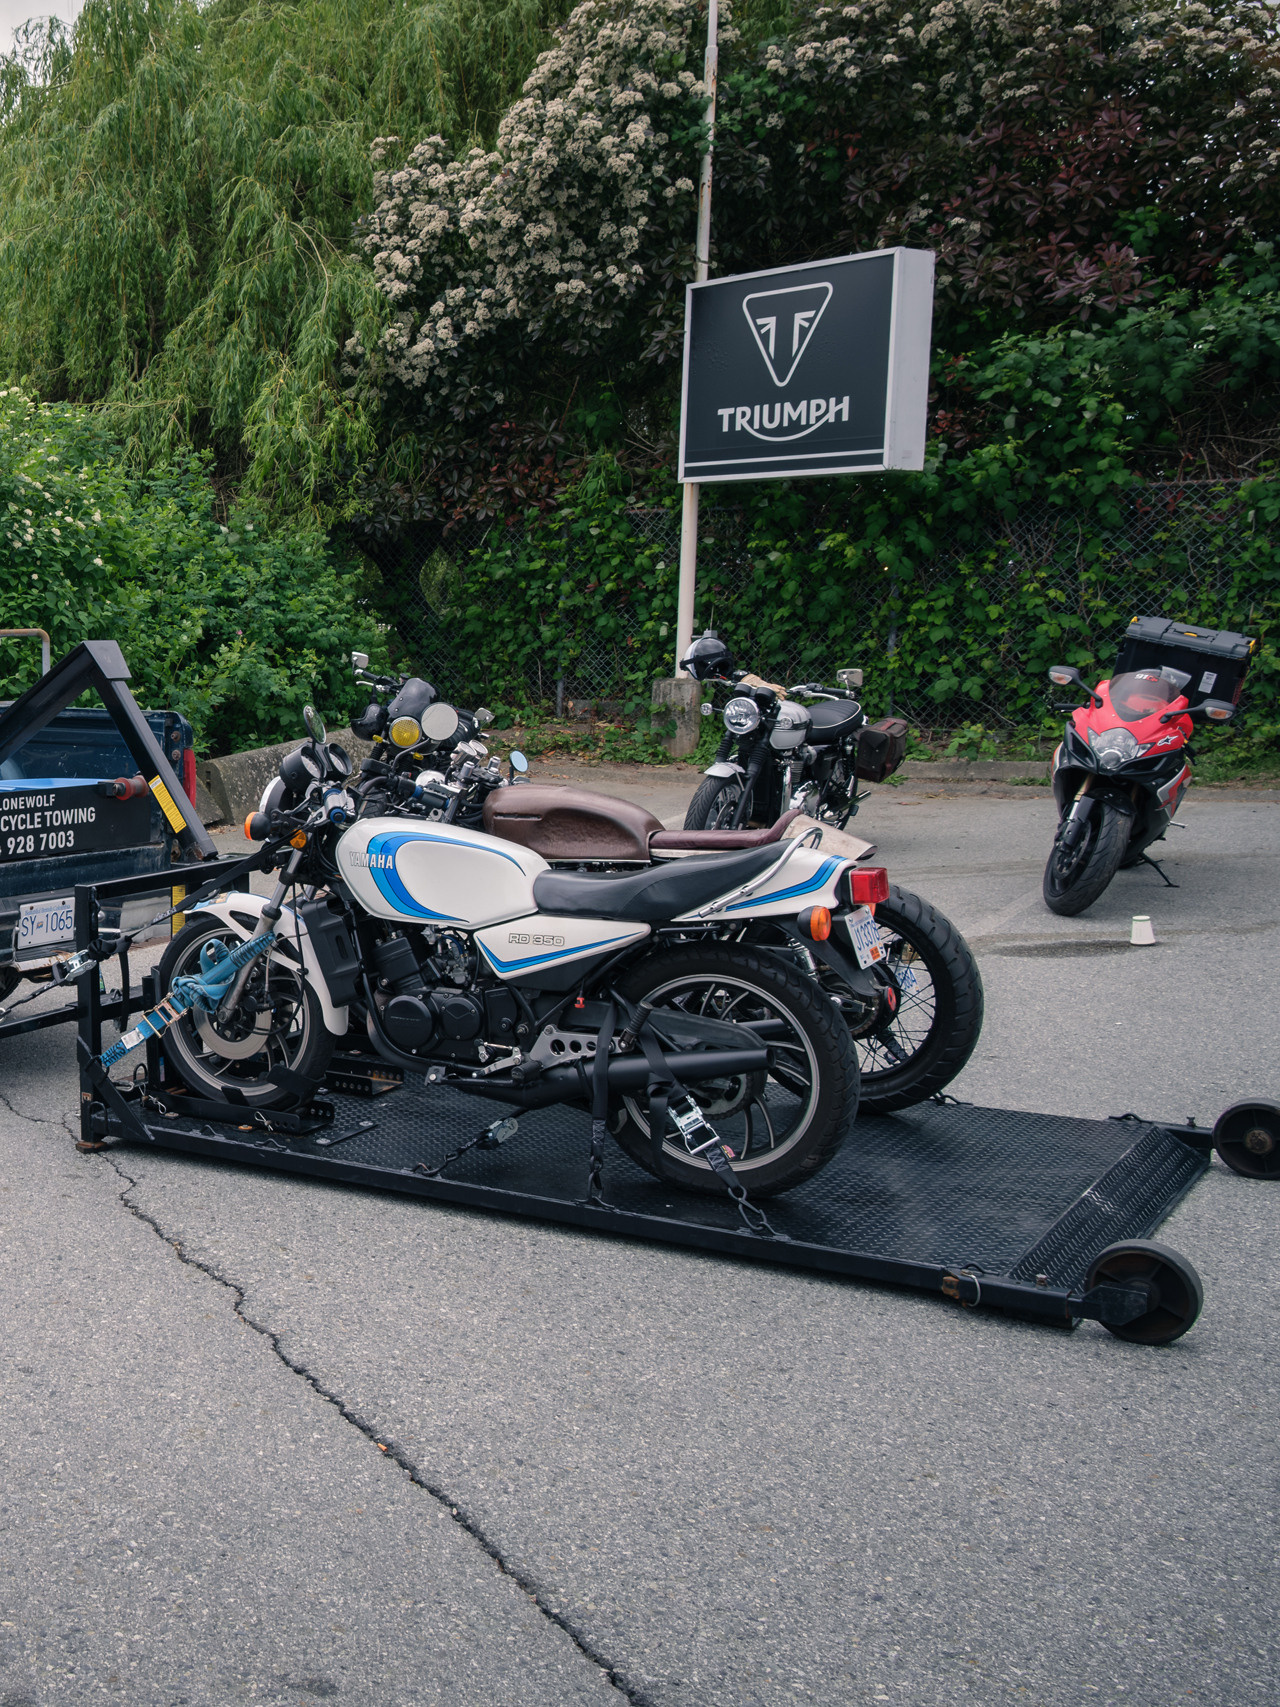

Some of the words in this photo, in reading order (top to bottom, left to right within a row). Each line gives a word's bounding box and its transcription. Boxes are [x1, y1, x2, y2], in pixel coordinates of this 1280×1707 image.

[717, 396, 850, 441] TRIUMPH
[44, 806, 96, 827] TOWING
[7, 835, 35, 855] 928
[39, 830, 74, 851] 7003
[349, 851, 393, 869] YAMAHA
[45, 909, 73, 933] 1065
[508, 932, 530, 944] RD
[532, 934, 565, 946] 350
